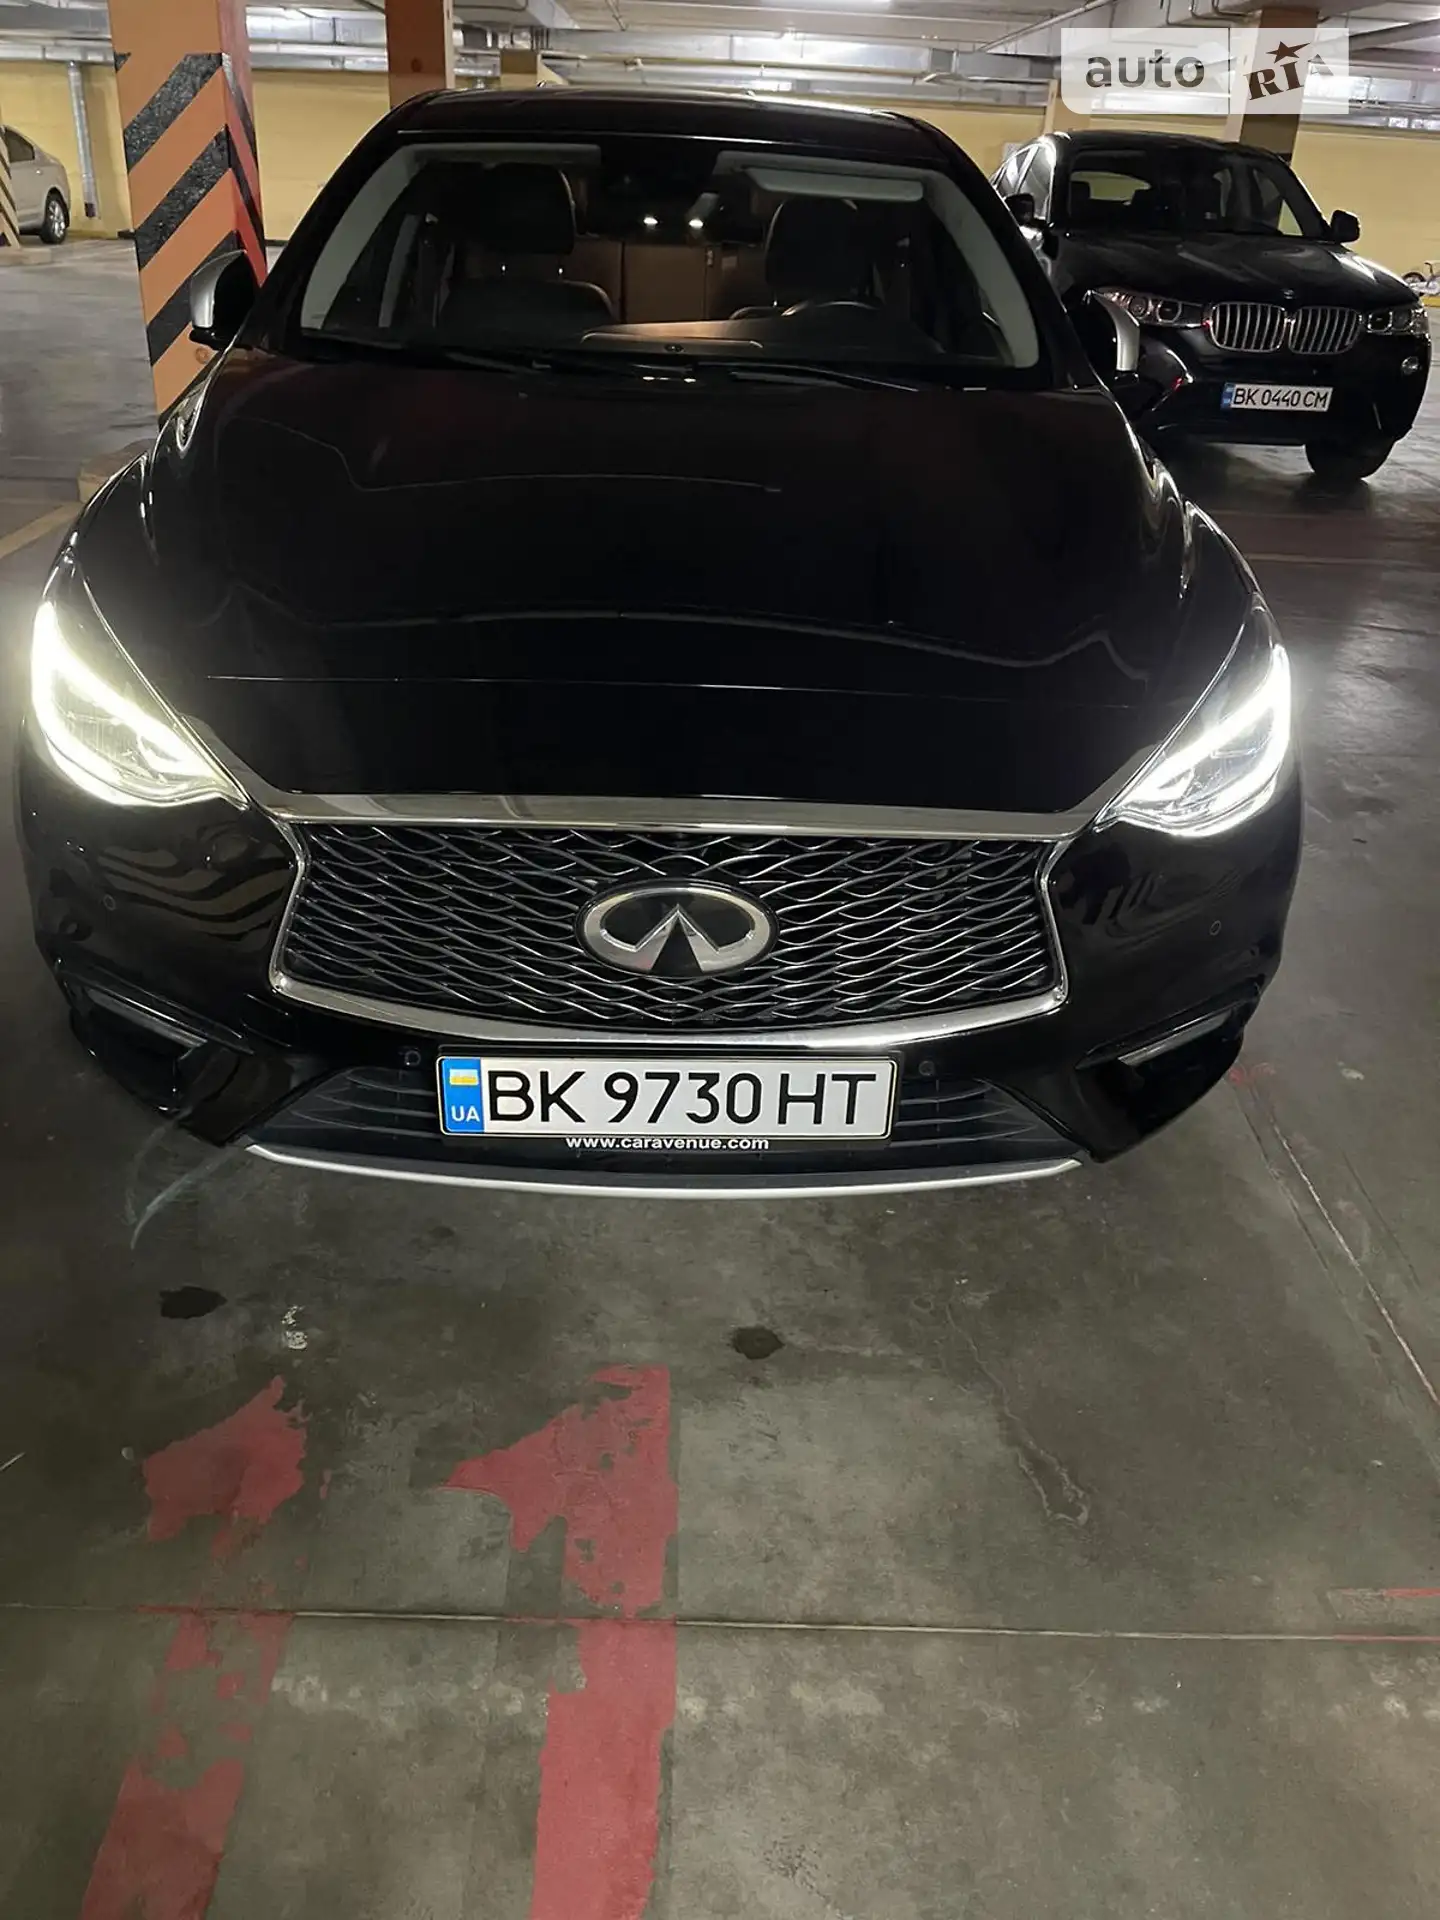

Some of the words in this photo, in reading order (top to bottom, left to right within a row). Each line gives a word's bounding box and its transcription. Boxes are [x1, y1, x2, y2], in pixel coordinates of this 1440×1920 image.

[1233, 388, 1259, 406] BK
[1261, 389, 1301, 407] 0440
[1303, 391, 1328, 408] CM
[487, 1070, 586, 1123] BK
[603, 1071, 763, 1125] 9730
[777, 1073, 877, 1125] HT
[450, 1104, 480, 1123] UA
[565, 1136, 770, 1150] www.caravenue.com
